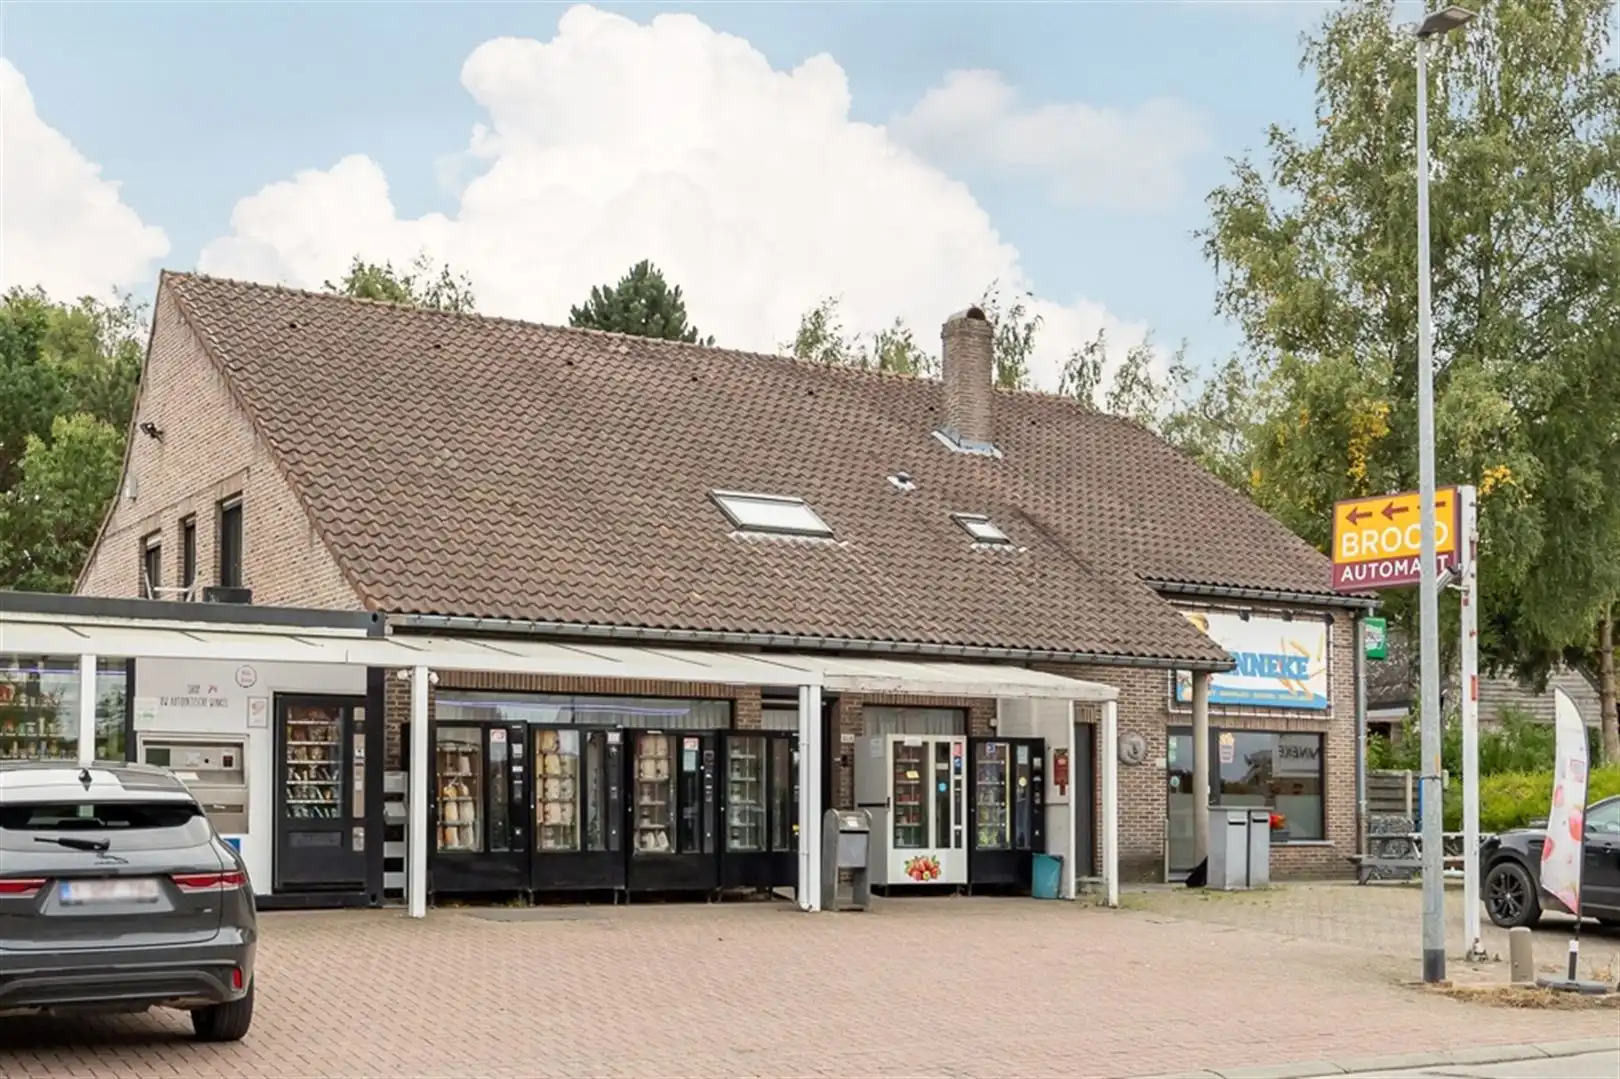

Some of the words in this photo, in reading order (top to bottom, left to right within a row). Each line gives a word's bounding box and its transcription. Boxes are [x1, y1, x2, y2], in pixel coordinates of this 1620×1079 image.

[1341, 520, 1449, 558] BROOD
[1340, 554, 1449, 583] AUTOMAT
[1226, 651, 1310, 681] NNEKE
